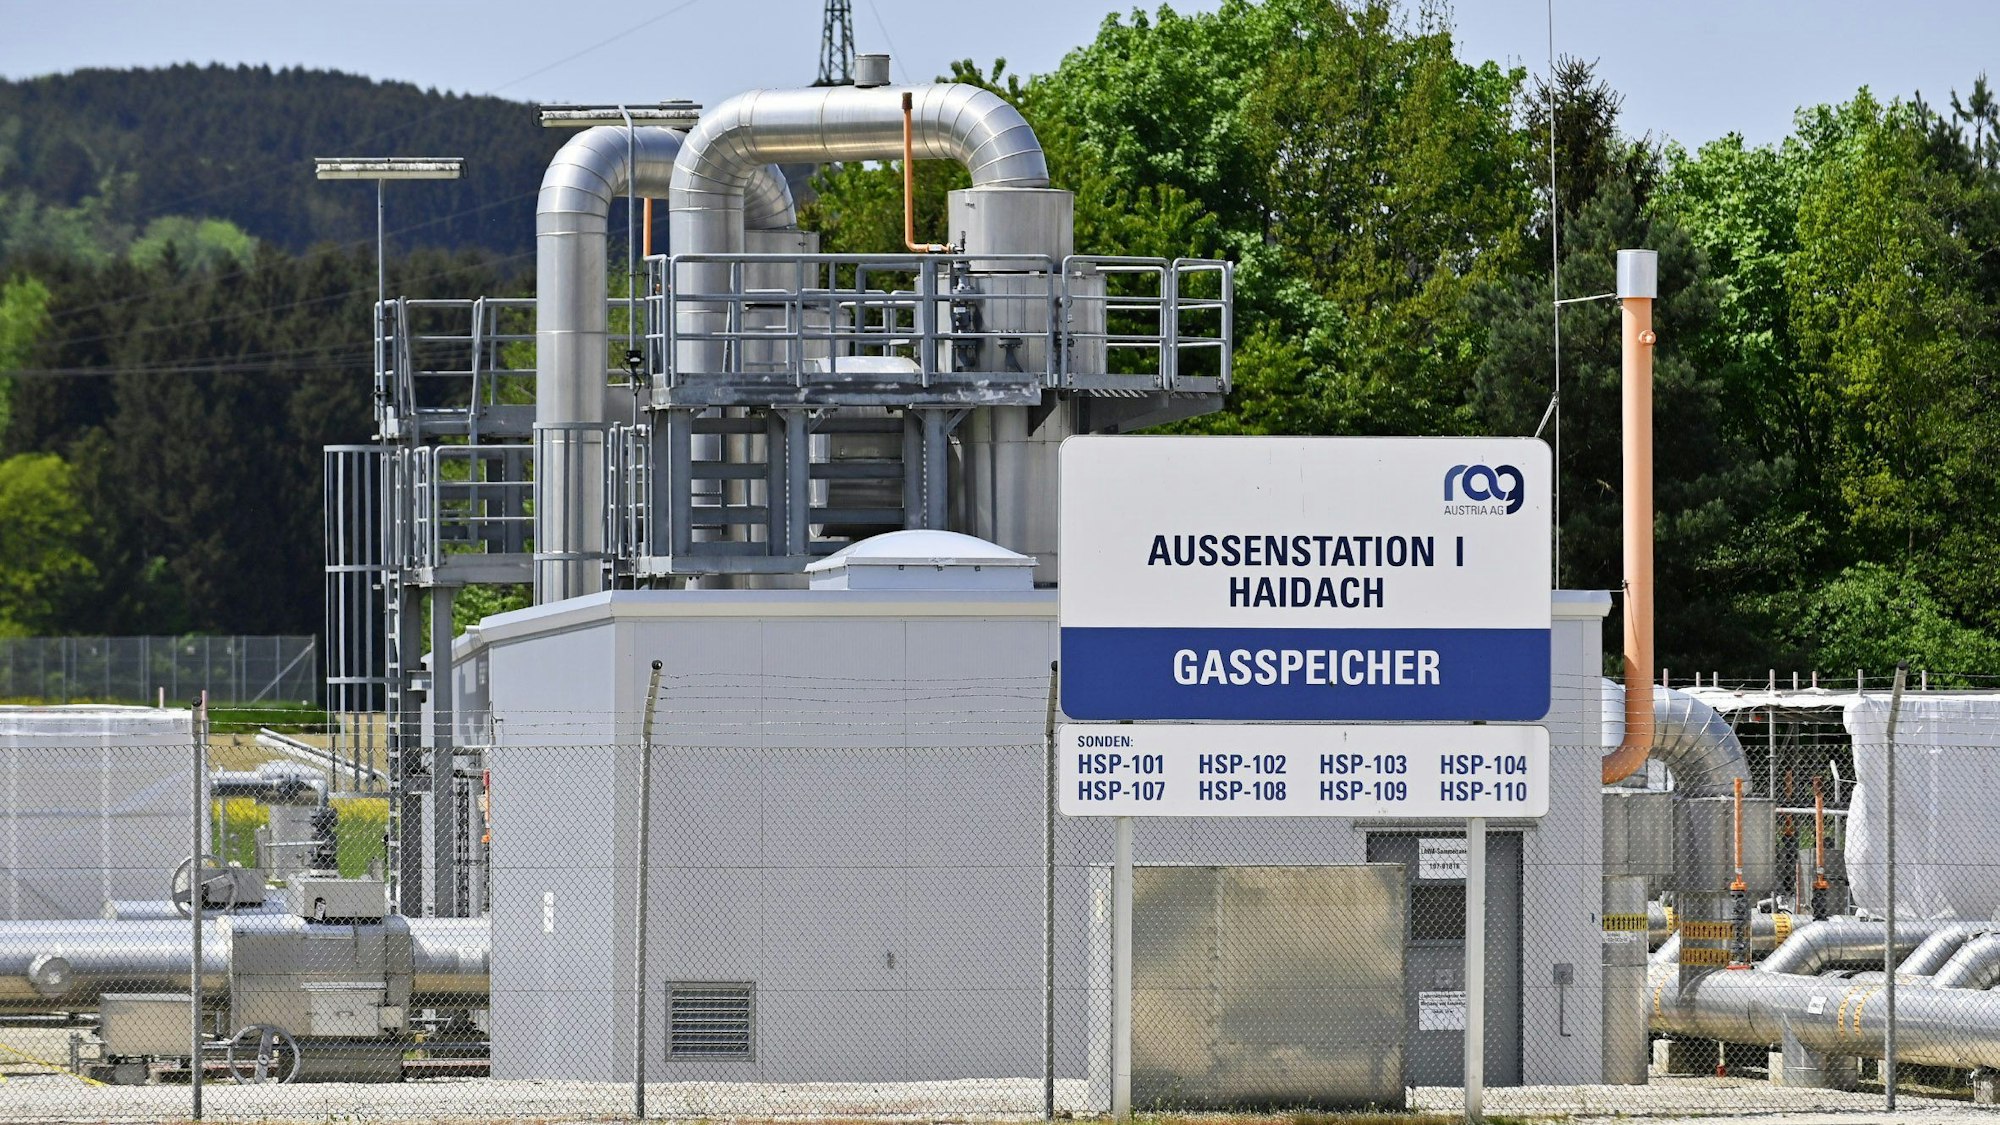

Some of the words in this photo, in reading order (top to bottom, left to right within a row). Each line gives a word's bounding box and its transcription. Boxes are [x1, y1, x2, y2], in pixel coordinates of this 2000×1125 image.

[1444, 505, 1488, 516] AUSTRIA
[1489, 505, 1504, 516] AG
[1147, 535, 1435, 567] AUSSENSTATION
[1456, 536, 1464, 567] I
[1229, 577, 1384, 609] HAIDACH
[1173, 648, 1441, 686] GASSPEICHER
[1077, 735, 1134, 748] SONDEN:
[1078, 754, 1164, 775] HSP-101
[1199, 754, 1287, 775] HSP-102
[1320, 754, 1407, 775] HSP-103
[1440, 754, 1528, 775] HSP-104
[1078, 781, 1166, 801] HSP-107
[1199, 781, 1287, 801] HSP-108
[1320, 781, 1407, 802] HSP-109
[1440, 781, 1528, 802] HSP-110
